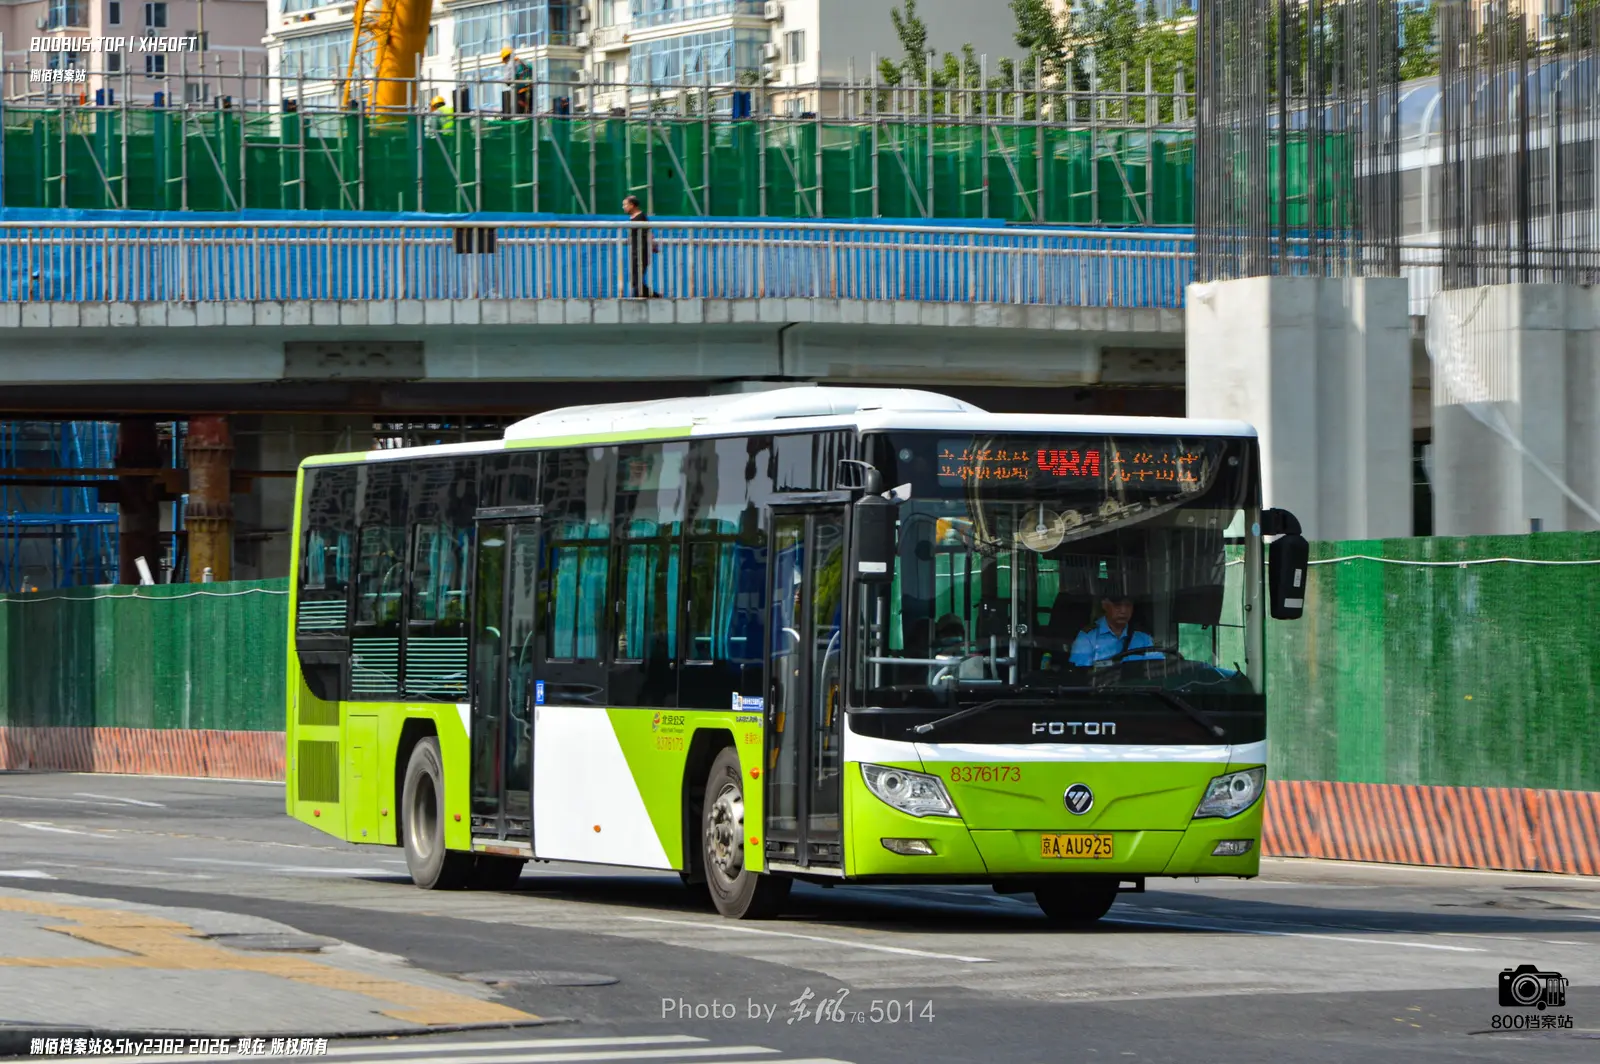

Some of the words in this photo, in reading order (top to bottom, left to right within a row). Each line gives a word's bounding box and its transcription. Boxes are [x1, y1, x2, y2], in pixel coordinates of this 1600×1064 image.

[662, 715, 685, 726] 北京公交
[1031, 721, 1117, 736] FOTON
[656, 735, 685, 751] 8376173
[950, 765, 1022, 783] 8376173
